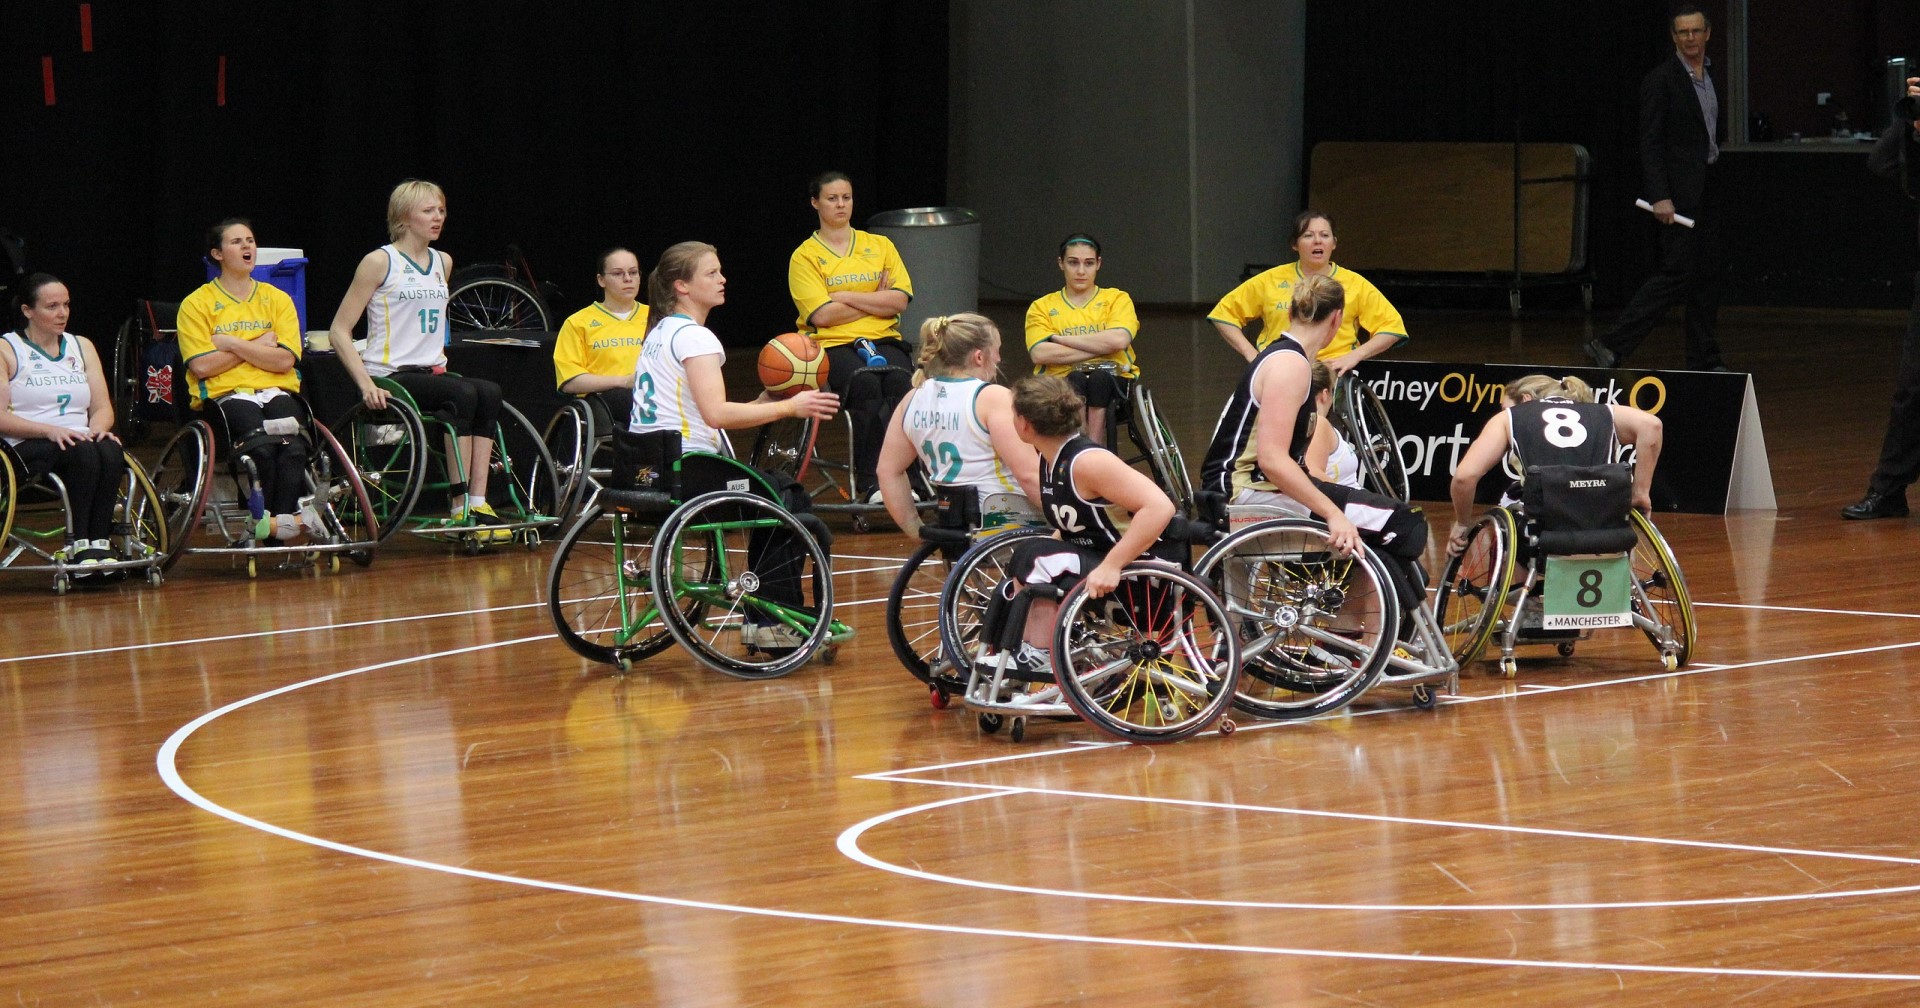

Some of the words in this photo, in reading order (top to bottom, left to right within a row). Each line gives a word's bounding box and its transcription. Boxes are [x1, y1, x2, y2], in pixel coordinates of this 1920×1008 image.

[399, 289, 449, 301] AUSTRAL
[418, 309, 440, 334] 15
[592, 337, 644, 351] AUSTRA
[25, 375, 88, 388] AUSTRAL
[57, 393, 73, 417] 7
[913, 409, 960, 431] CHAPLIN
[1541, 407, 1588, 449] 8
[921, 439, 964, 483] 12
[1349, 423, 1471, 488] port
[1569, 479, 1607, 489] MEYRA
[1051, 504, 1087, 533] 12
[1576, 569, 1603, 608] 8
[1554, 616, 1621, 627] MANCHESTER
